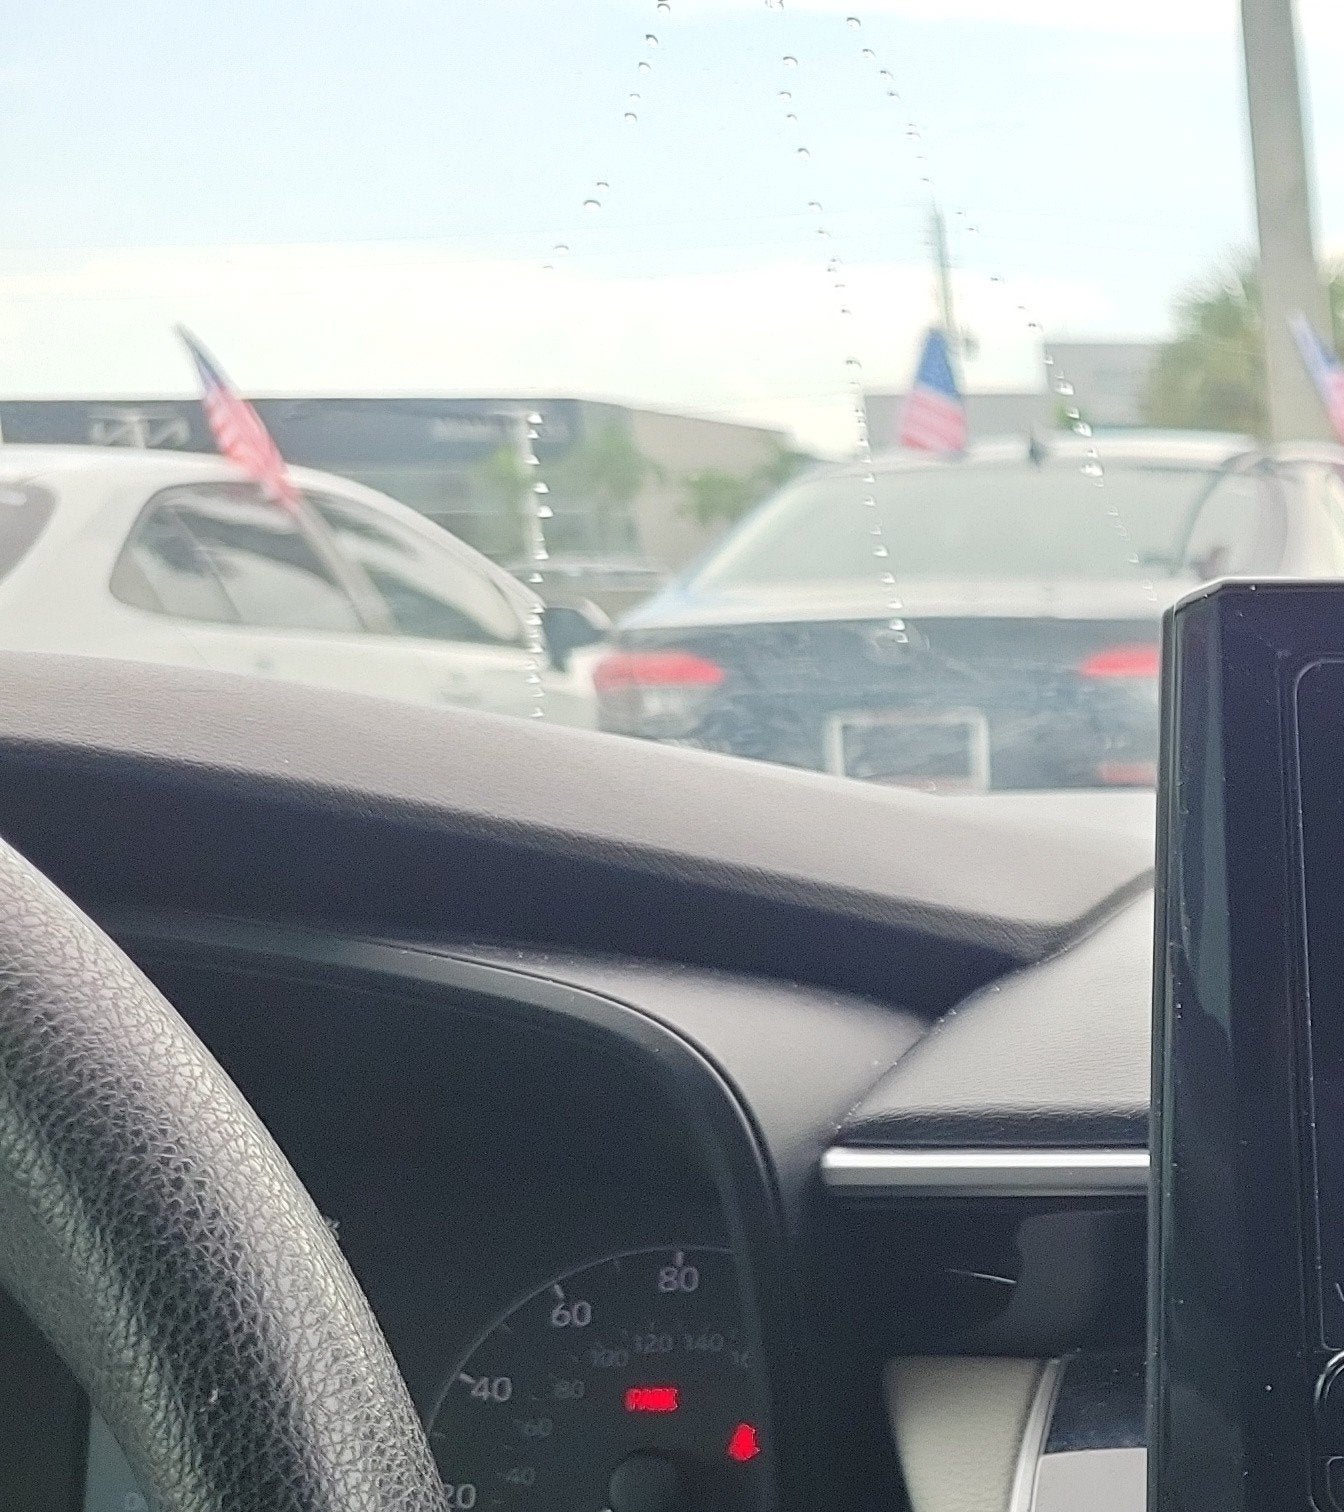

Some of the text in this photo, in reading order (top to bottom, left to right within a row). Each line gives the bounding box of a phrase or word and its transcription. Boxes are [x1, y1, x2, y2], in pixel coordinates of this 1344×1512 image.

[658, 1266, 699, 1292] 80
[551, 1301, 592, 1327] 60
[470, 1376, 513, 1402] 40
